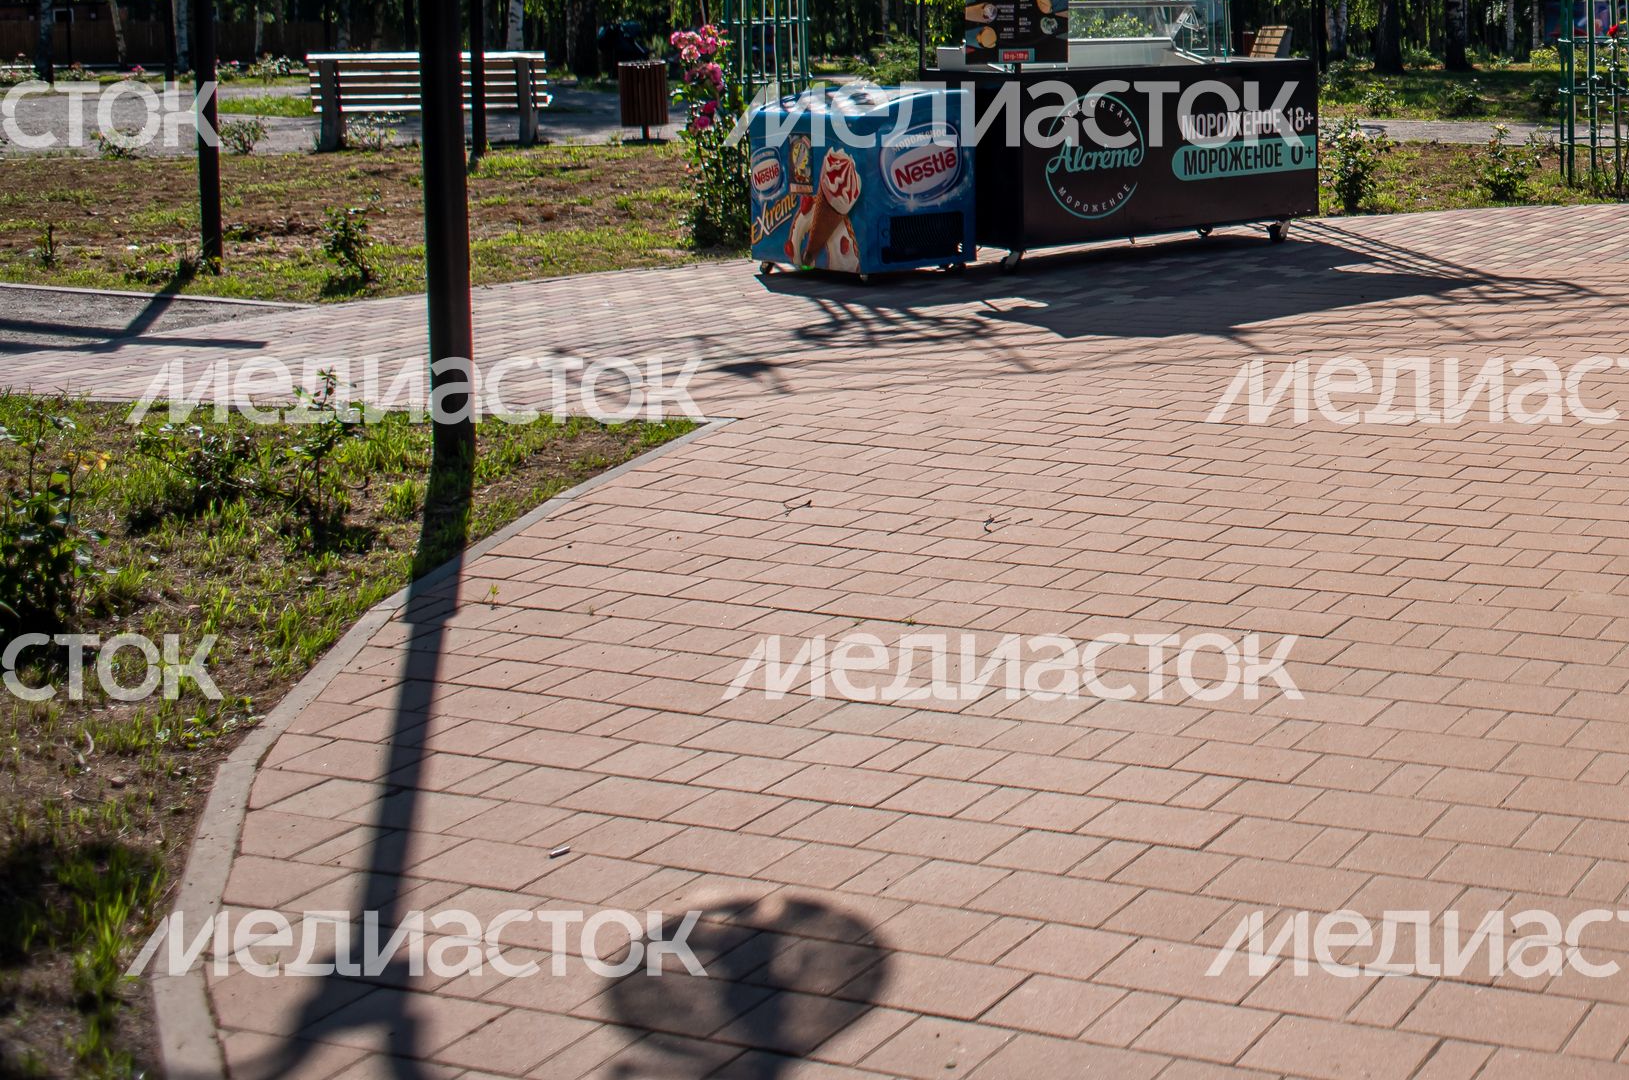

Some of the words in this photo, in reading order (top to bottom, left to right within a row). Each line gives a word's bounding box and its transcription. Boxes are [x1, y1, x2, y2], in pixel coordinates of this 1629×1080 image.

[1089, 99, 1132, 127] CREAM
[1181, 108, 1282, 141] МОРОЖЕНОЕ
[1287, 106, 1314, 132] 18+
[895, 147, 957, 188] Nestlé
[1183, 143, 1283, 176] МОРОЖЕНОЕ
[1290, 142, 1314, 165] 0+
[1058, 183, 1131, 213] МОРОЖЕНОЕ
